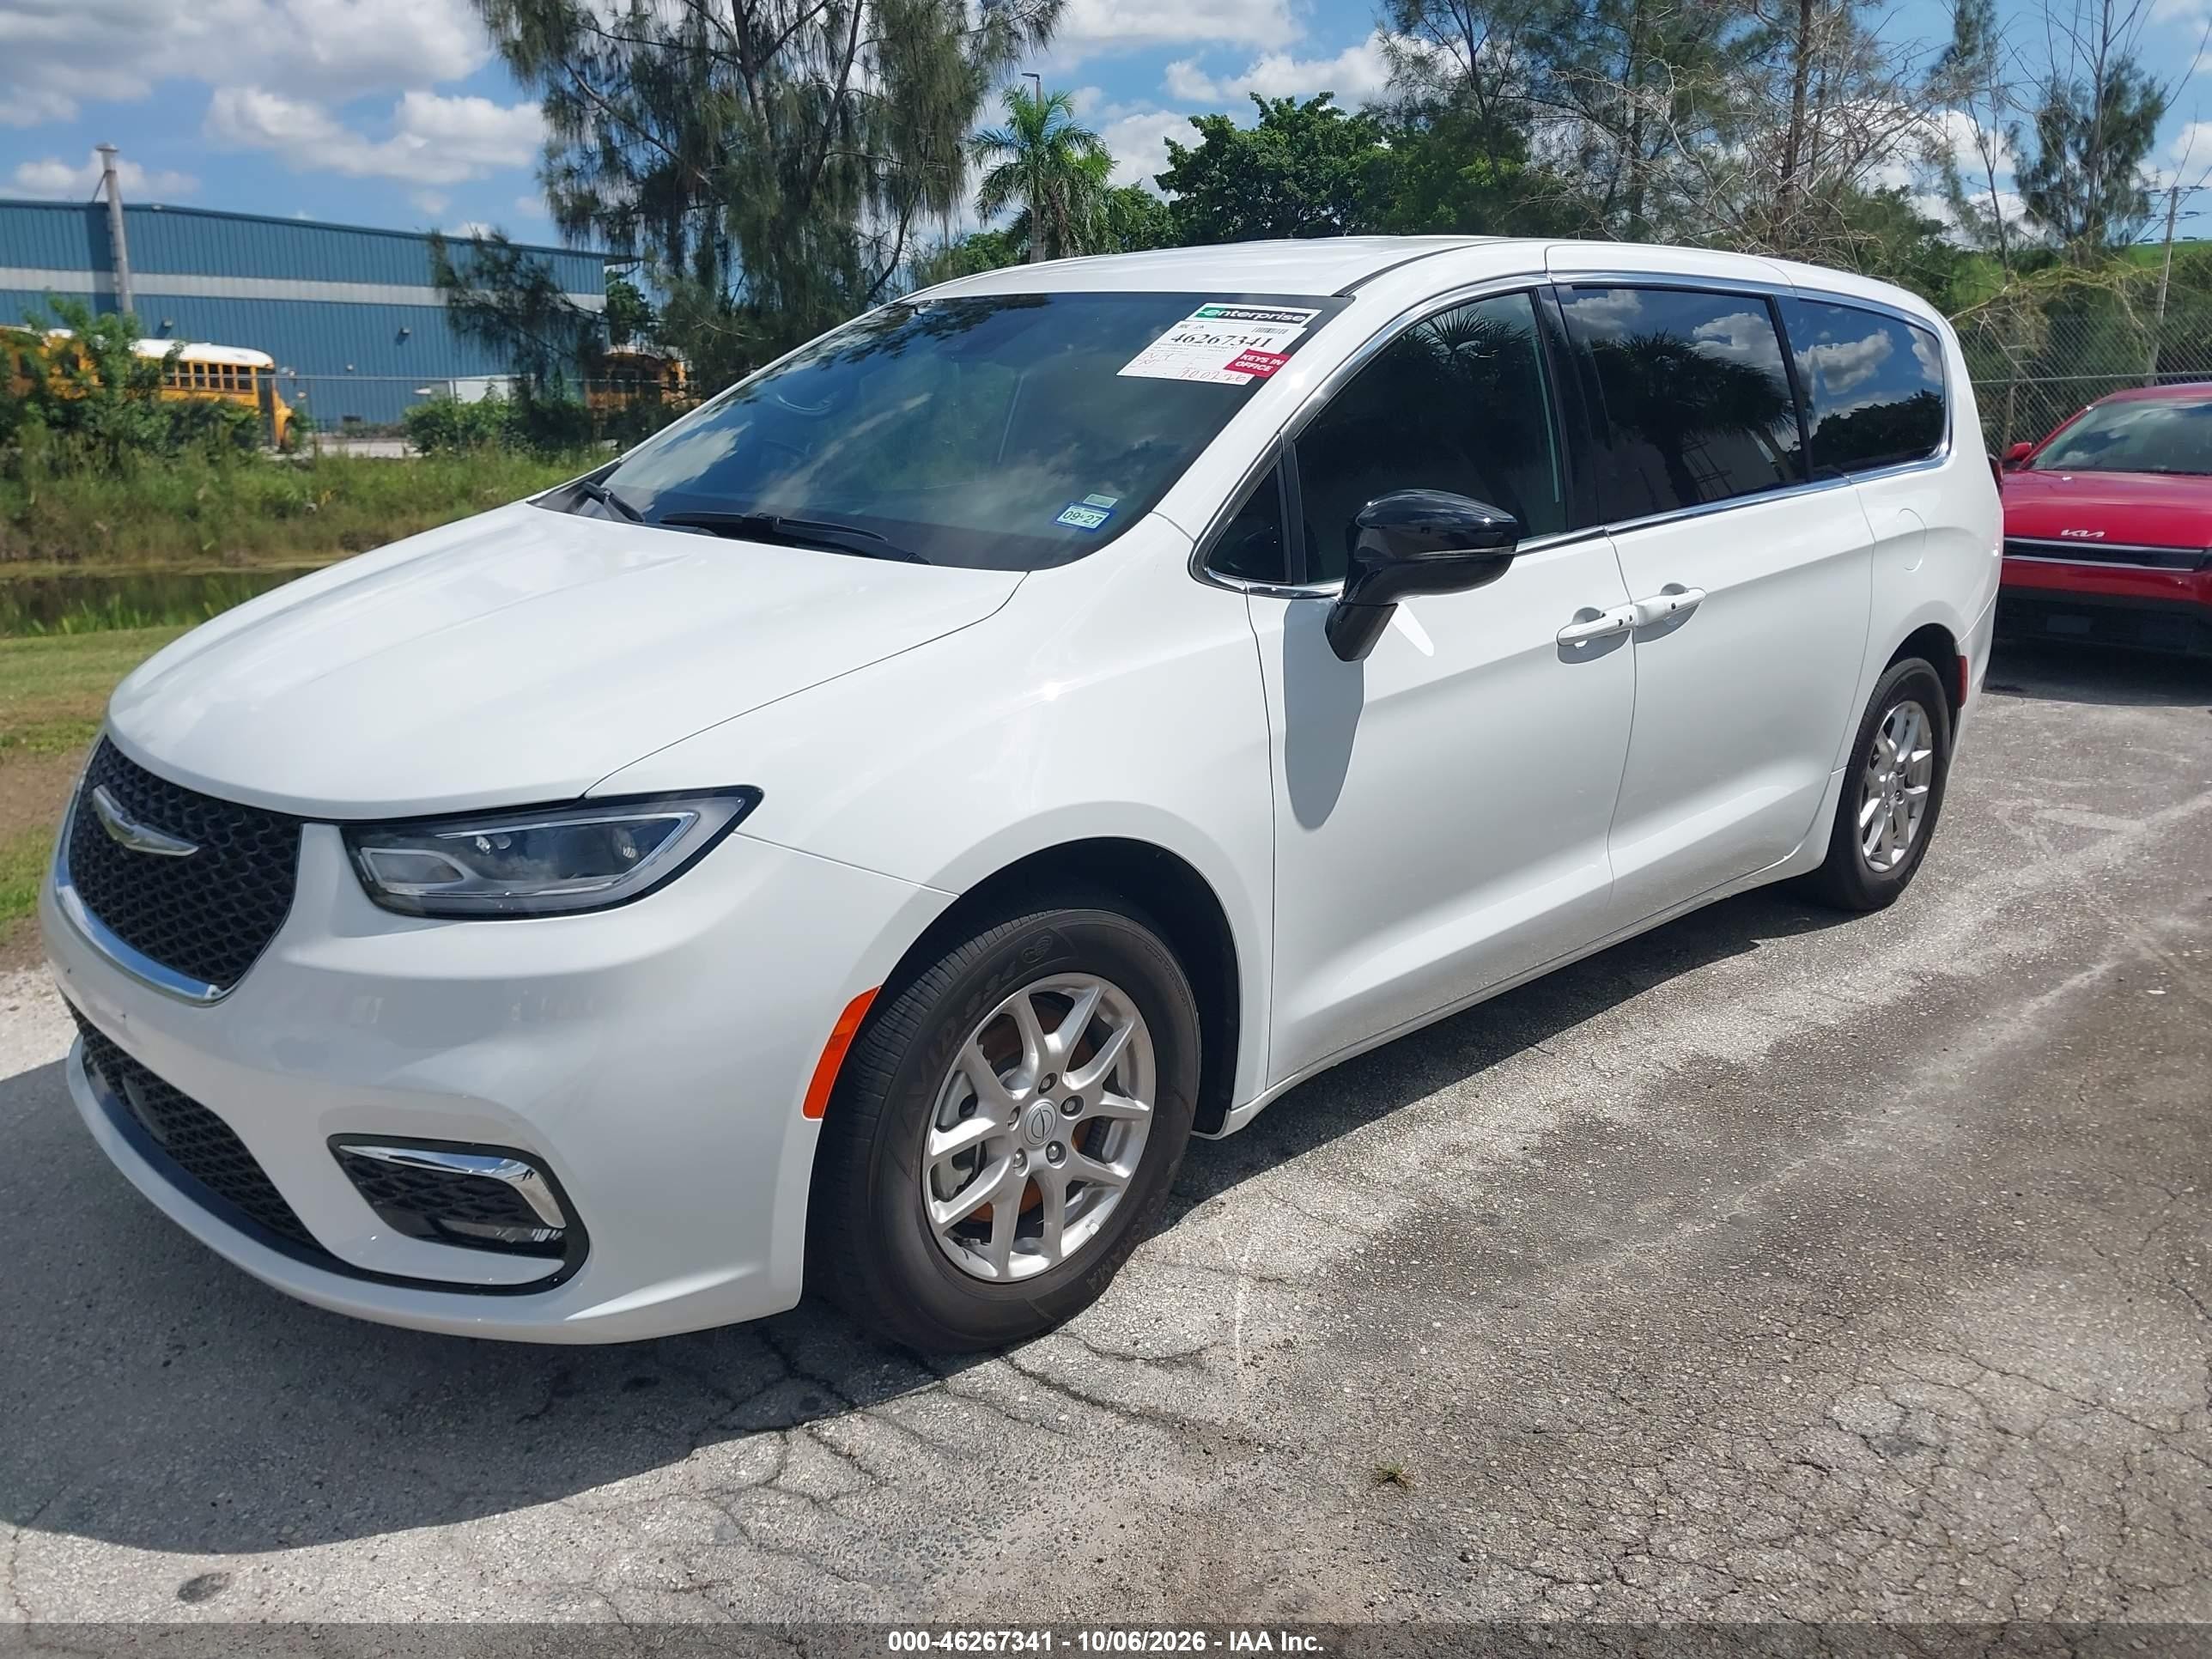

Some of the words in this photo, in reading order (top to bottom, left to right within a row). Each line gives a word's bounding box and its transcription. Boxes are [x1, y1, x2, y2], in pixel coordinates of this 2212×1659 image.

[1201, 308, 1306, 322] enterprise
[1170, 331, 1274, 349] 46267341
[1235, 361, 1275, 372] OFFICE
[1240, 354, 1269, 363] KEYS
[1269, 357, 1285, 366] IN
